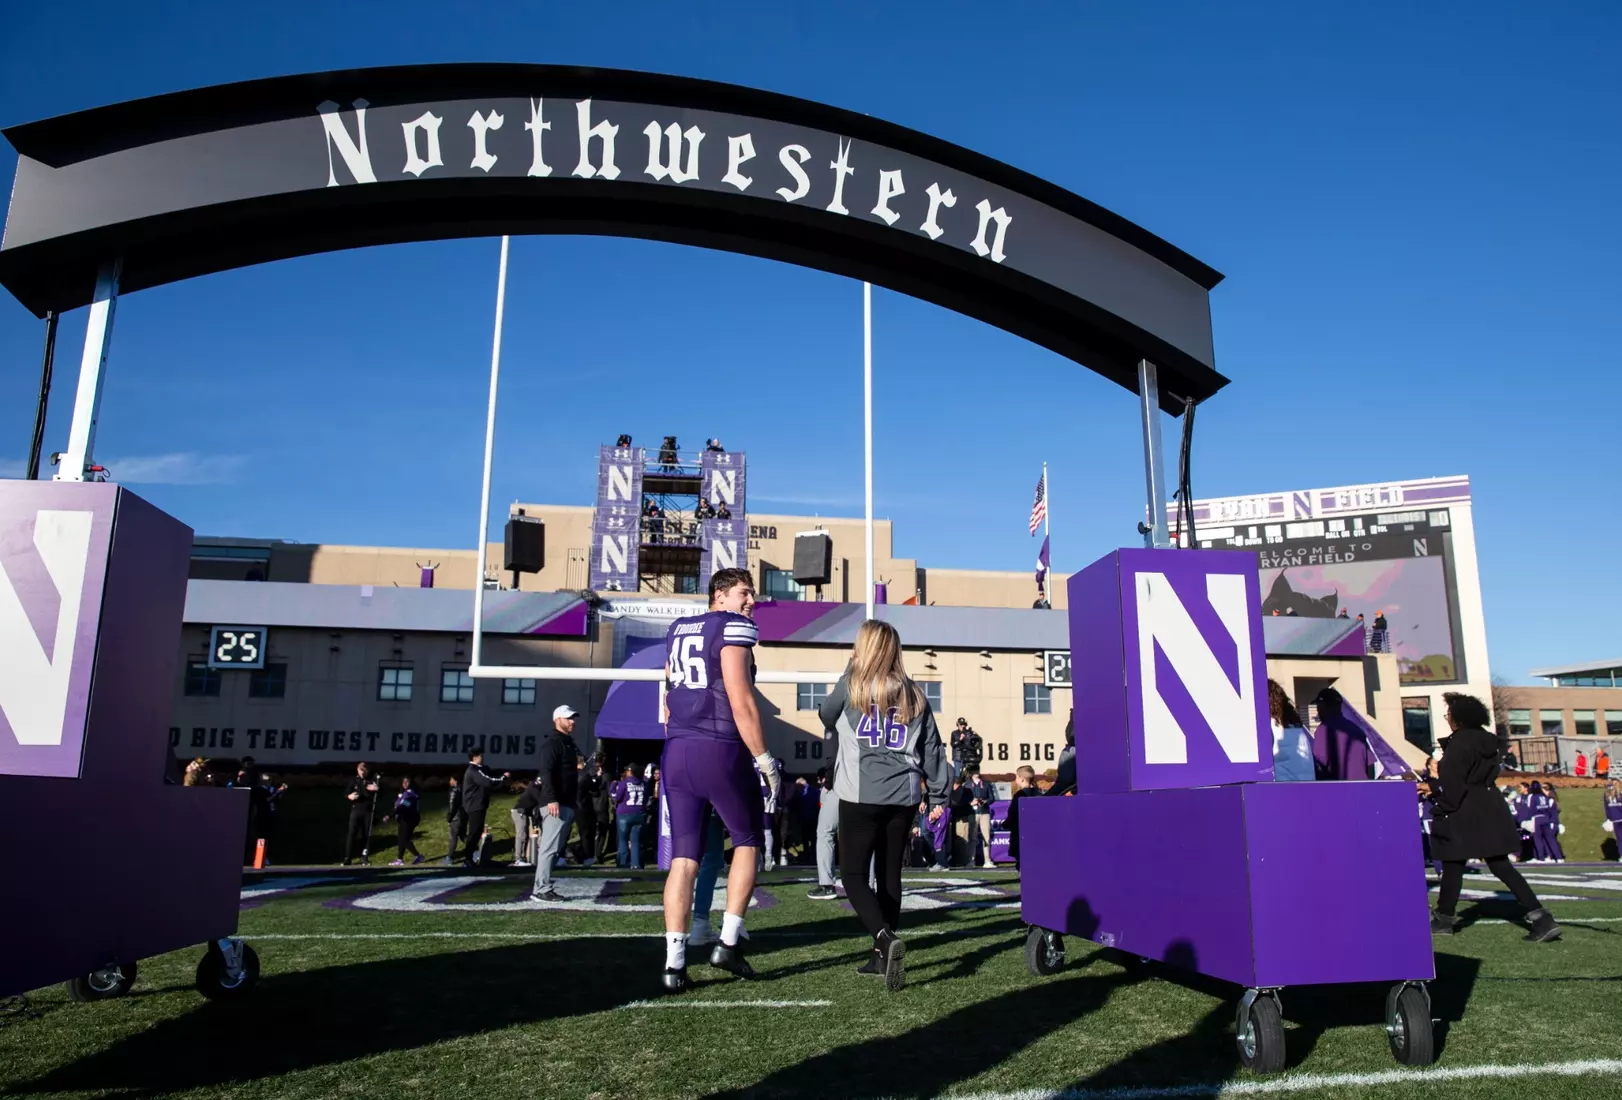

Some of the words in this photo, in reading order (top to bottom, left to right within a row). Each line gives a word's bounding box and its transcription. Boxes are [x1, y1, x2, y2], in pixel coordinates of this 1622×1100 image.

[315, 96, 1013, 264] Northwestern
[608, 464, 633, 501] N
[711, 469, 735, 505] N
[1210, 499, 1269, 523] RYAN
[1293, 491, 1314, 520] N
[1335, 486, 1404, 511] FIELD
[747, 525, 778, 540] ENA
[1325, 530, 1341, 540] BALL
[601, 535, 629, 574] N
[711, 539, 737, 576] N
[1259, 545, 1337, 560] ELCOME
[1348, 543, 1372, 552] TO
[1413, 537, 1429, 557] N
[1261, 556, 1302, 569] RYAN
[1308, 552, 1356, 565] FIELD
[646, 605, 687, 616] WALKER
[217, 632, 257, 662] 25
[669, 636, 708, 690] 46
[1050, 655, 1072, 682] 2
[1134, 572, 1260, 765] N
[190, 727, 236, 748] BIG
[246, 728, 298, 750] TEN
[308, 730, 381, 752] WEST
[390, 731, 537, 756] CHAMPIONS
[856, 703, 908, 751] 46
[987, 742, 1009, 761] 18
[1019, 742, 1055, 761] BIG
[991, 837, 1011, 846] ANK
